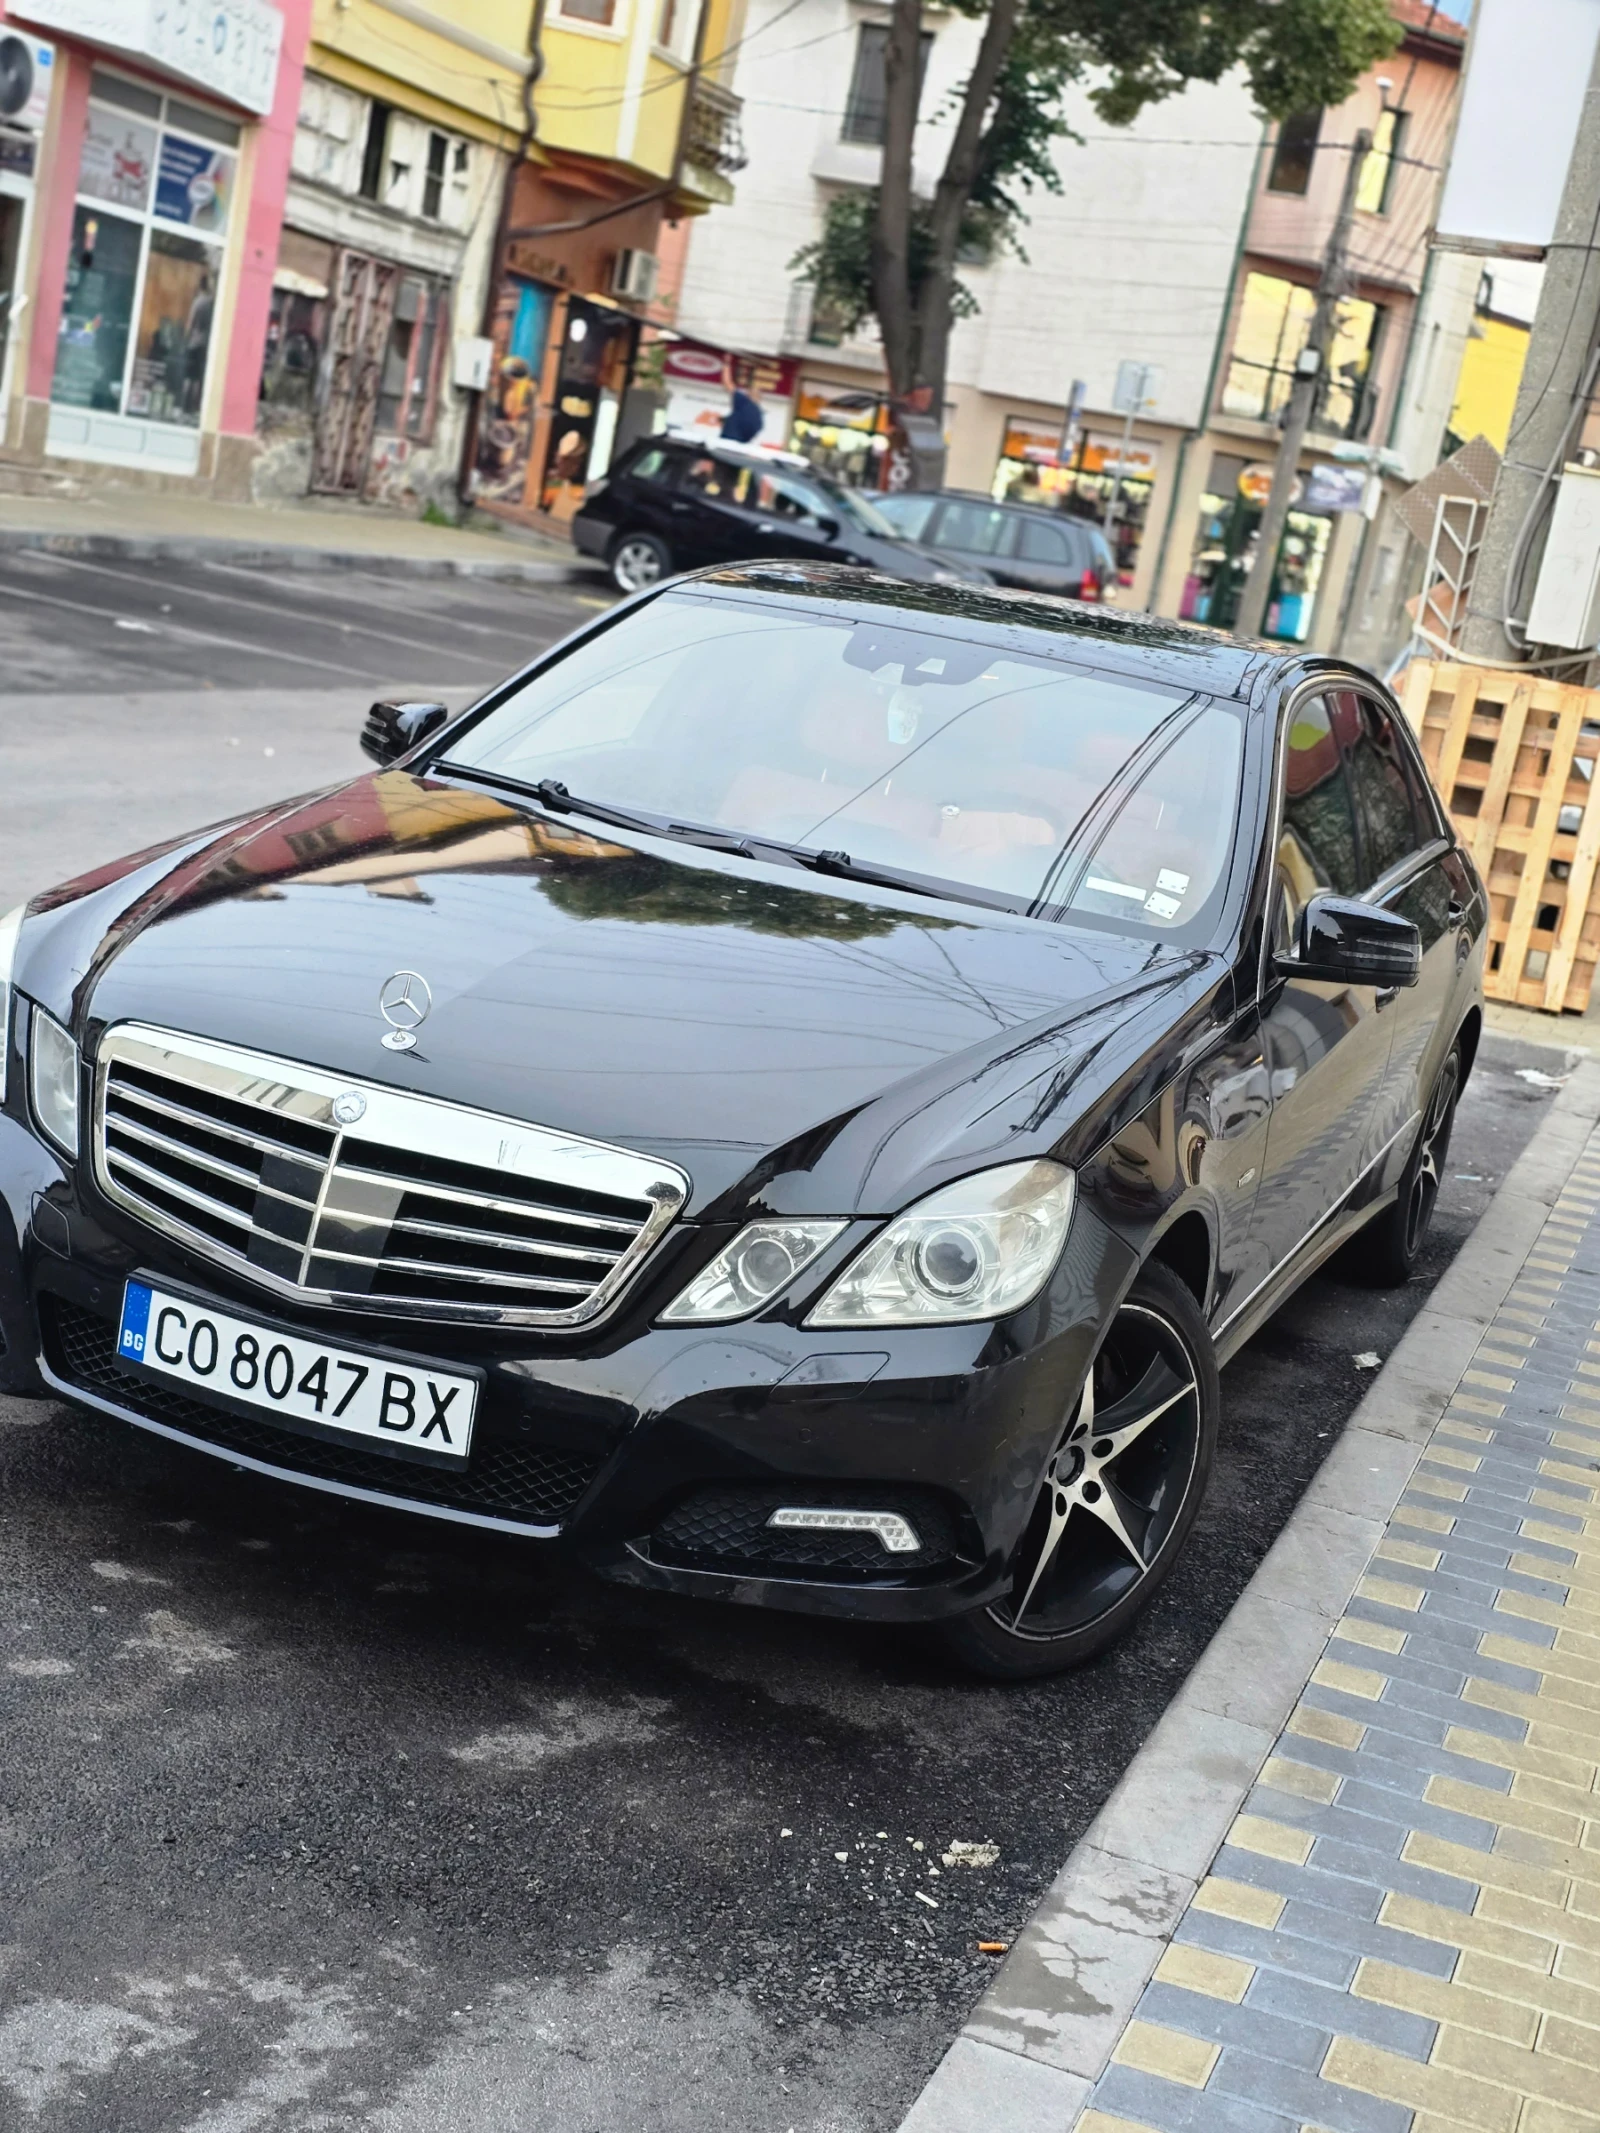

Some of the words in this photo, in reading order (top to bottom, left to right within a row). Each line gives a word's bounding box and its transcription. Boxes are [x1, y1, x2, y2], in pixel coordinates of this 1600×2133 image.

[122, 1329, 144, 1352] BG
[154, 1306, 219, 1376] CO
[230, 1333, 369, 1418] 8047
[378, 1371, 460, 1444] BX
